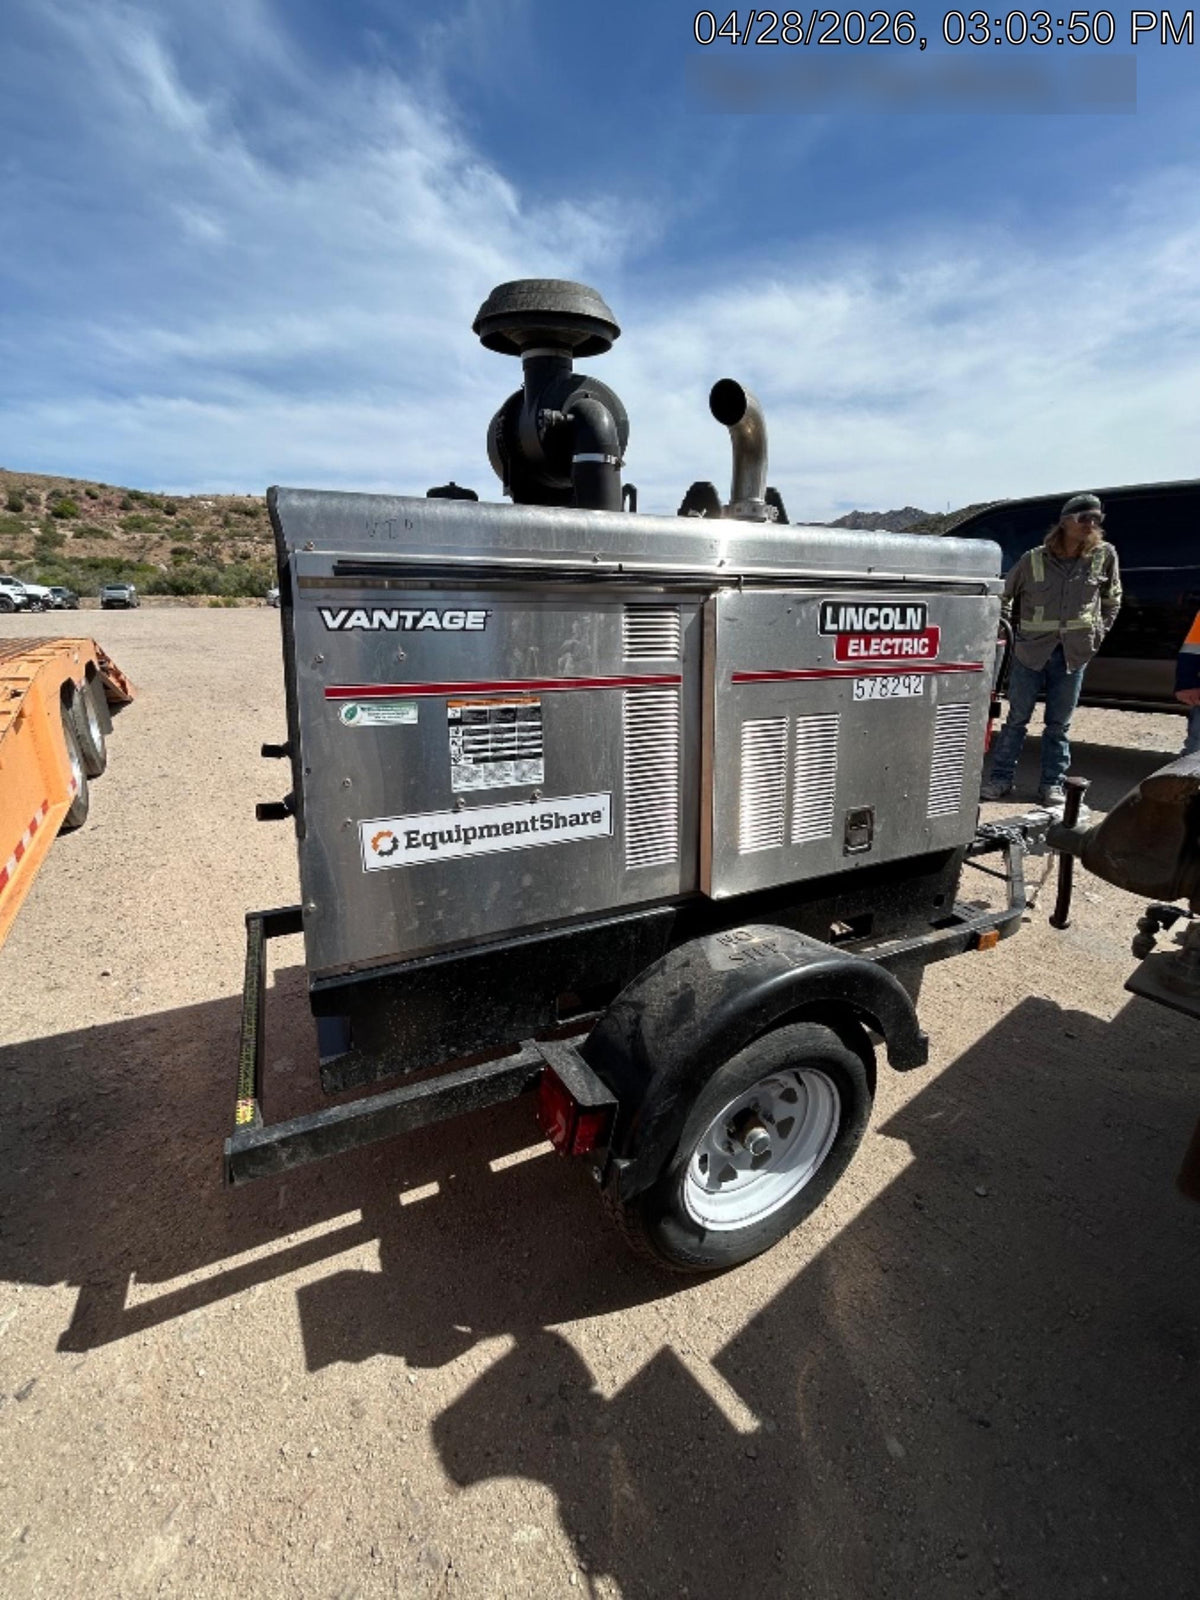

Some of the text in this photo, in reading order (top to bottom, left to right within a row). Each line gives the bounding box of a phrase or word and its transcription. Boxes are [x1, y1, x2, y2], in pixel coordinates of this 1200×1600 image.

[320, 607, 488, 631] VANTAGE
[825, 606, 922, 631] LINCOLN
[847, 637, 929, 657] ELECTRIC
[854, 674, 922, 699] 578292
[404, 809, 603, 850] EquipmentShare
